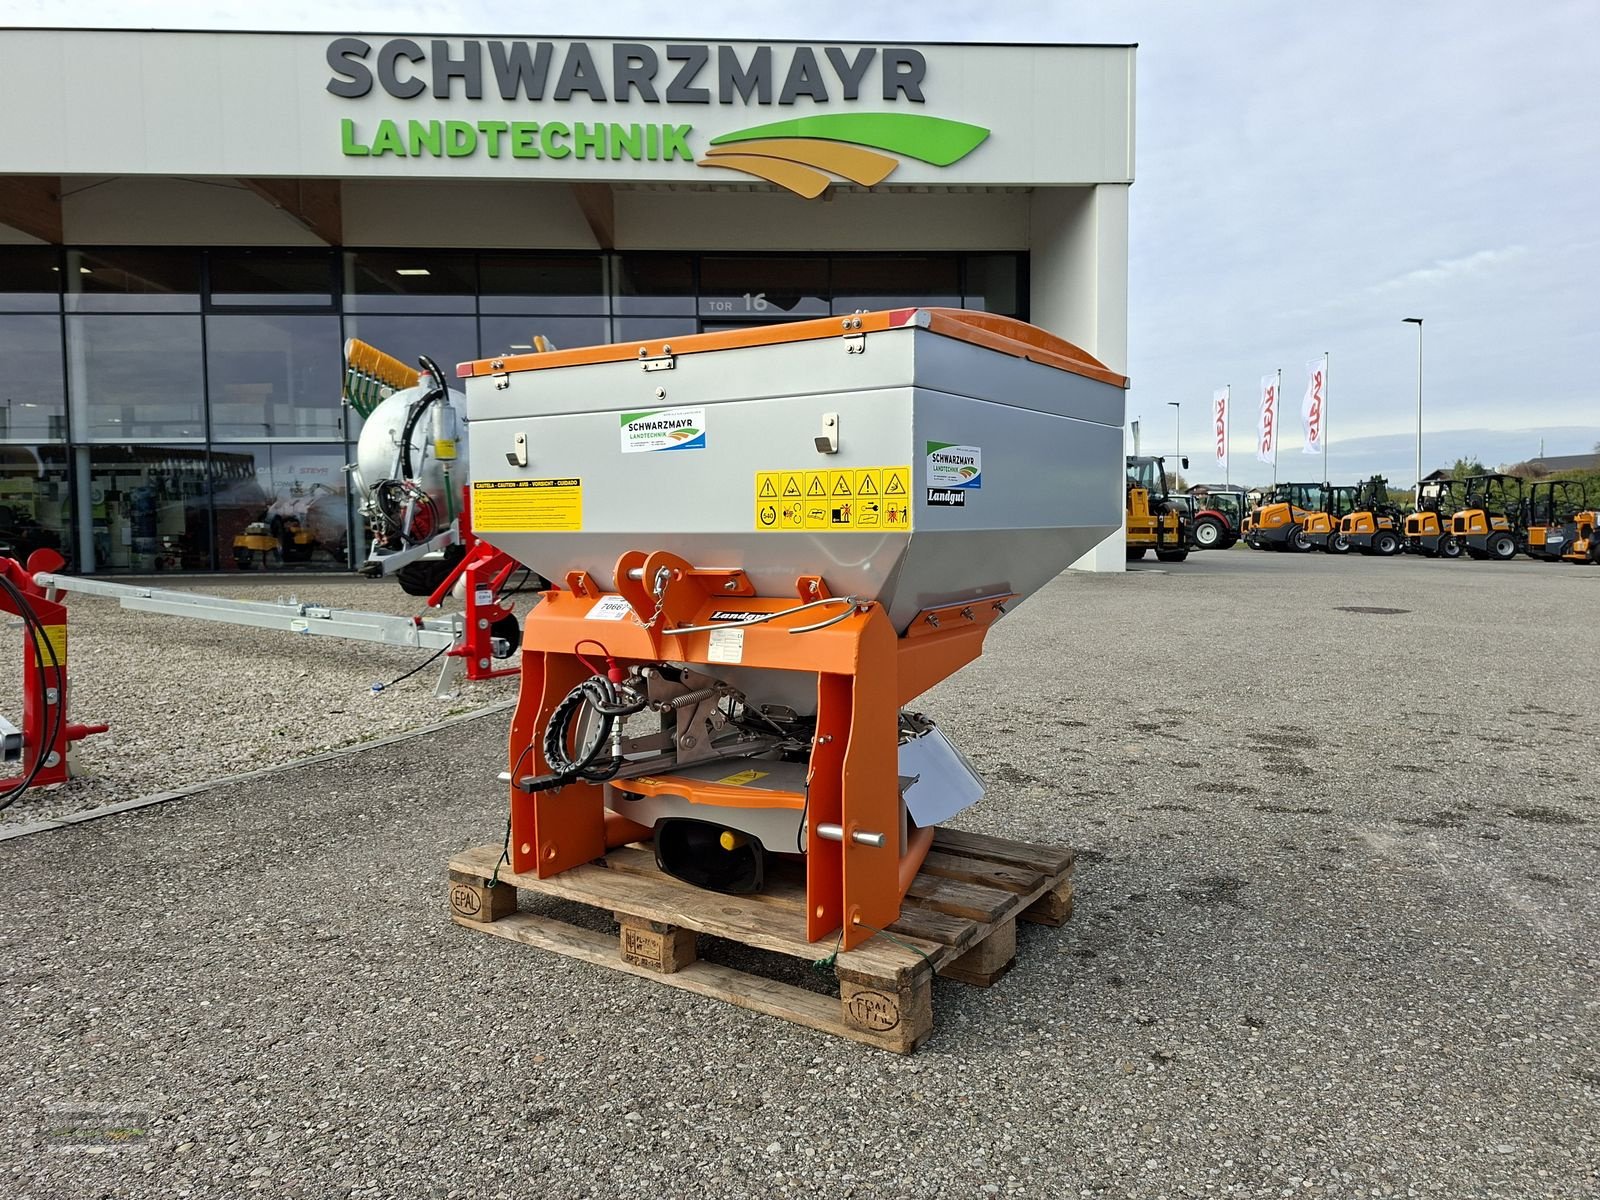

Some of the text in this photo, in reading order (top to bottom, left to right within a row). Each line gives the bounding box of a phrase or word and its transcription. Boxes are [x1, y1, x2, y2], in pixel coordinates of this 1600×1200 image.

[325, 37, 927, 104] SCHWARZMAYR
[340, 118, 695, 162] LANDTECHNIK
[708, 293, 768, 311] TOR 16
[628, 419, 693, 432] SCHWARZMAYR
[629, 432, 667, 440] LANDTECHNIK
[932, 453, 975, 465] SCHWARZMAYR
[928, 489, 964, 505] Landgut
[455, 889, 477, 911] EPAL
